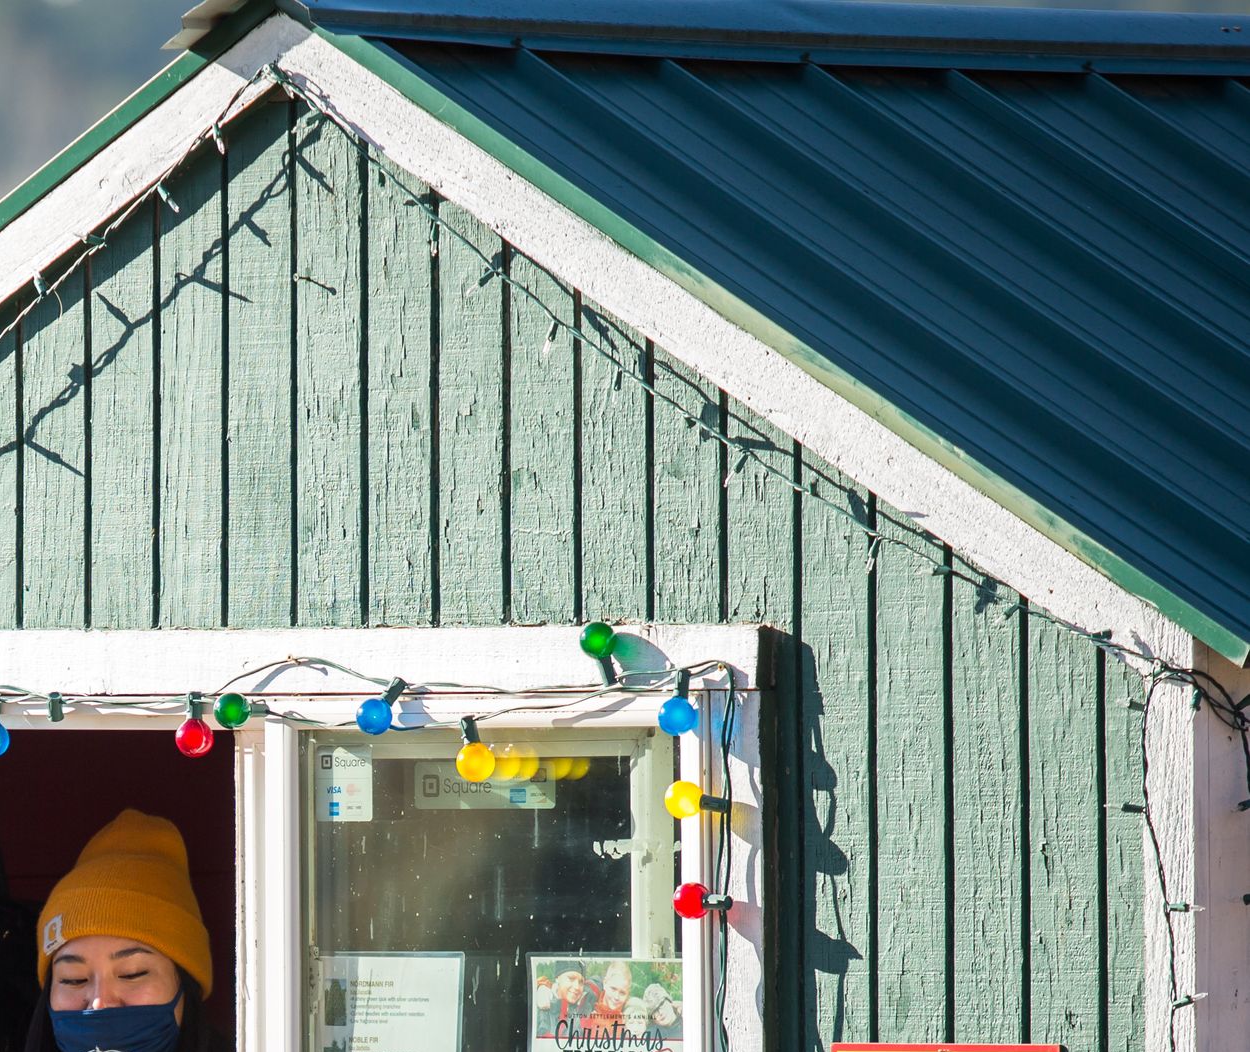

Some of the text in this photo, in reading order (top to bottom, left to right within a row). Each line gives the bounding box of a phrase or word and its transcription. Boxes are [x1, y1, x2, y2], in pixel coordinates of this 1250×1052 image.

[334, 757, 366, 769] Square
[327, 786, 342, 794] VISA
[443, 778, 492, 797] Square
[369, 1036, 379, 1044] FIR
[555, 1018, 667, 1052] Christmas
